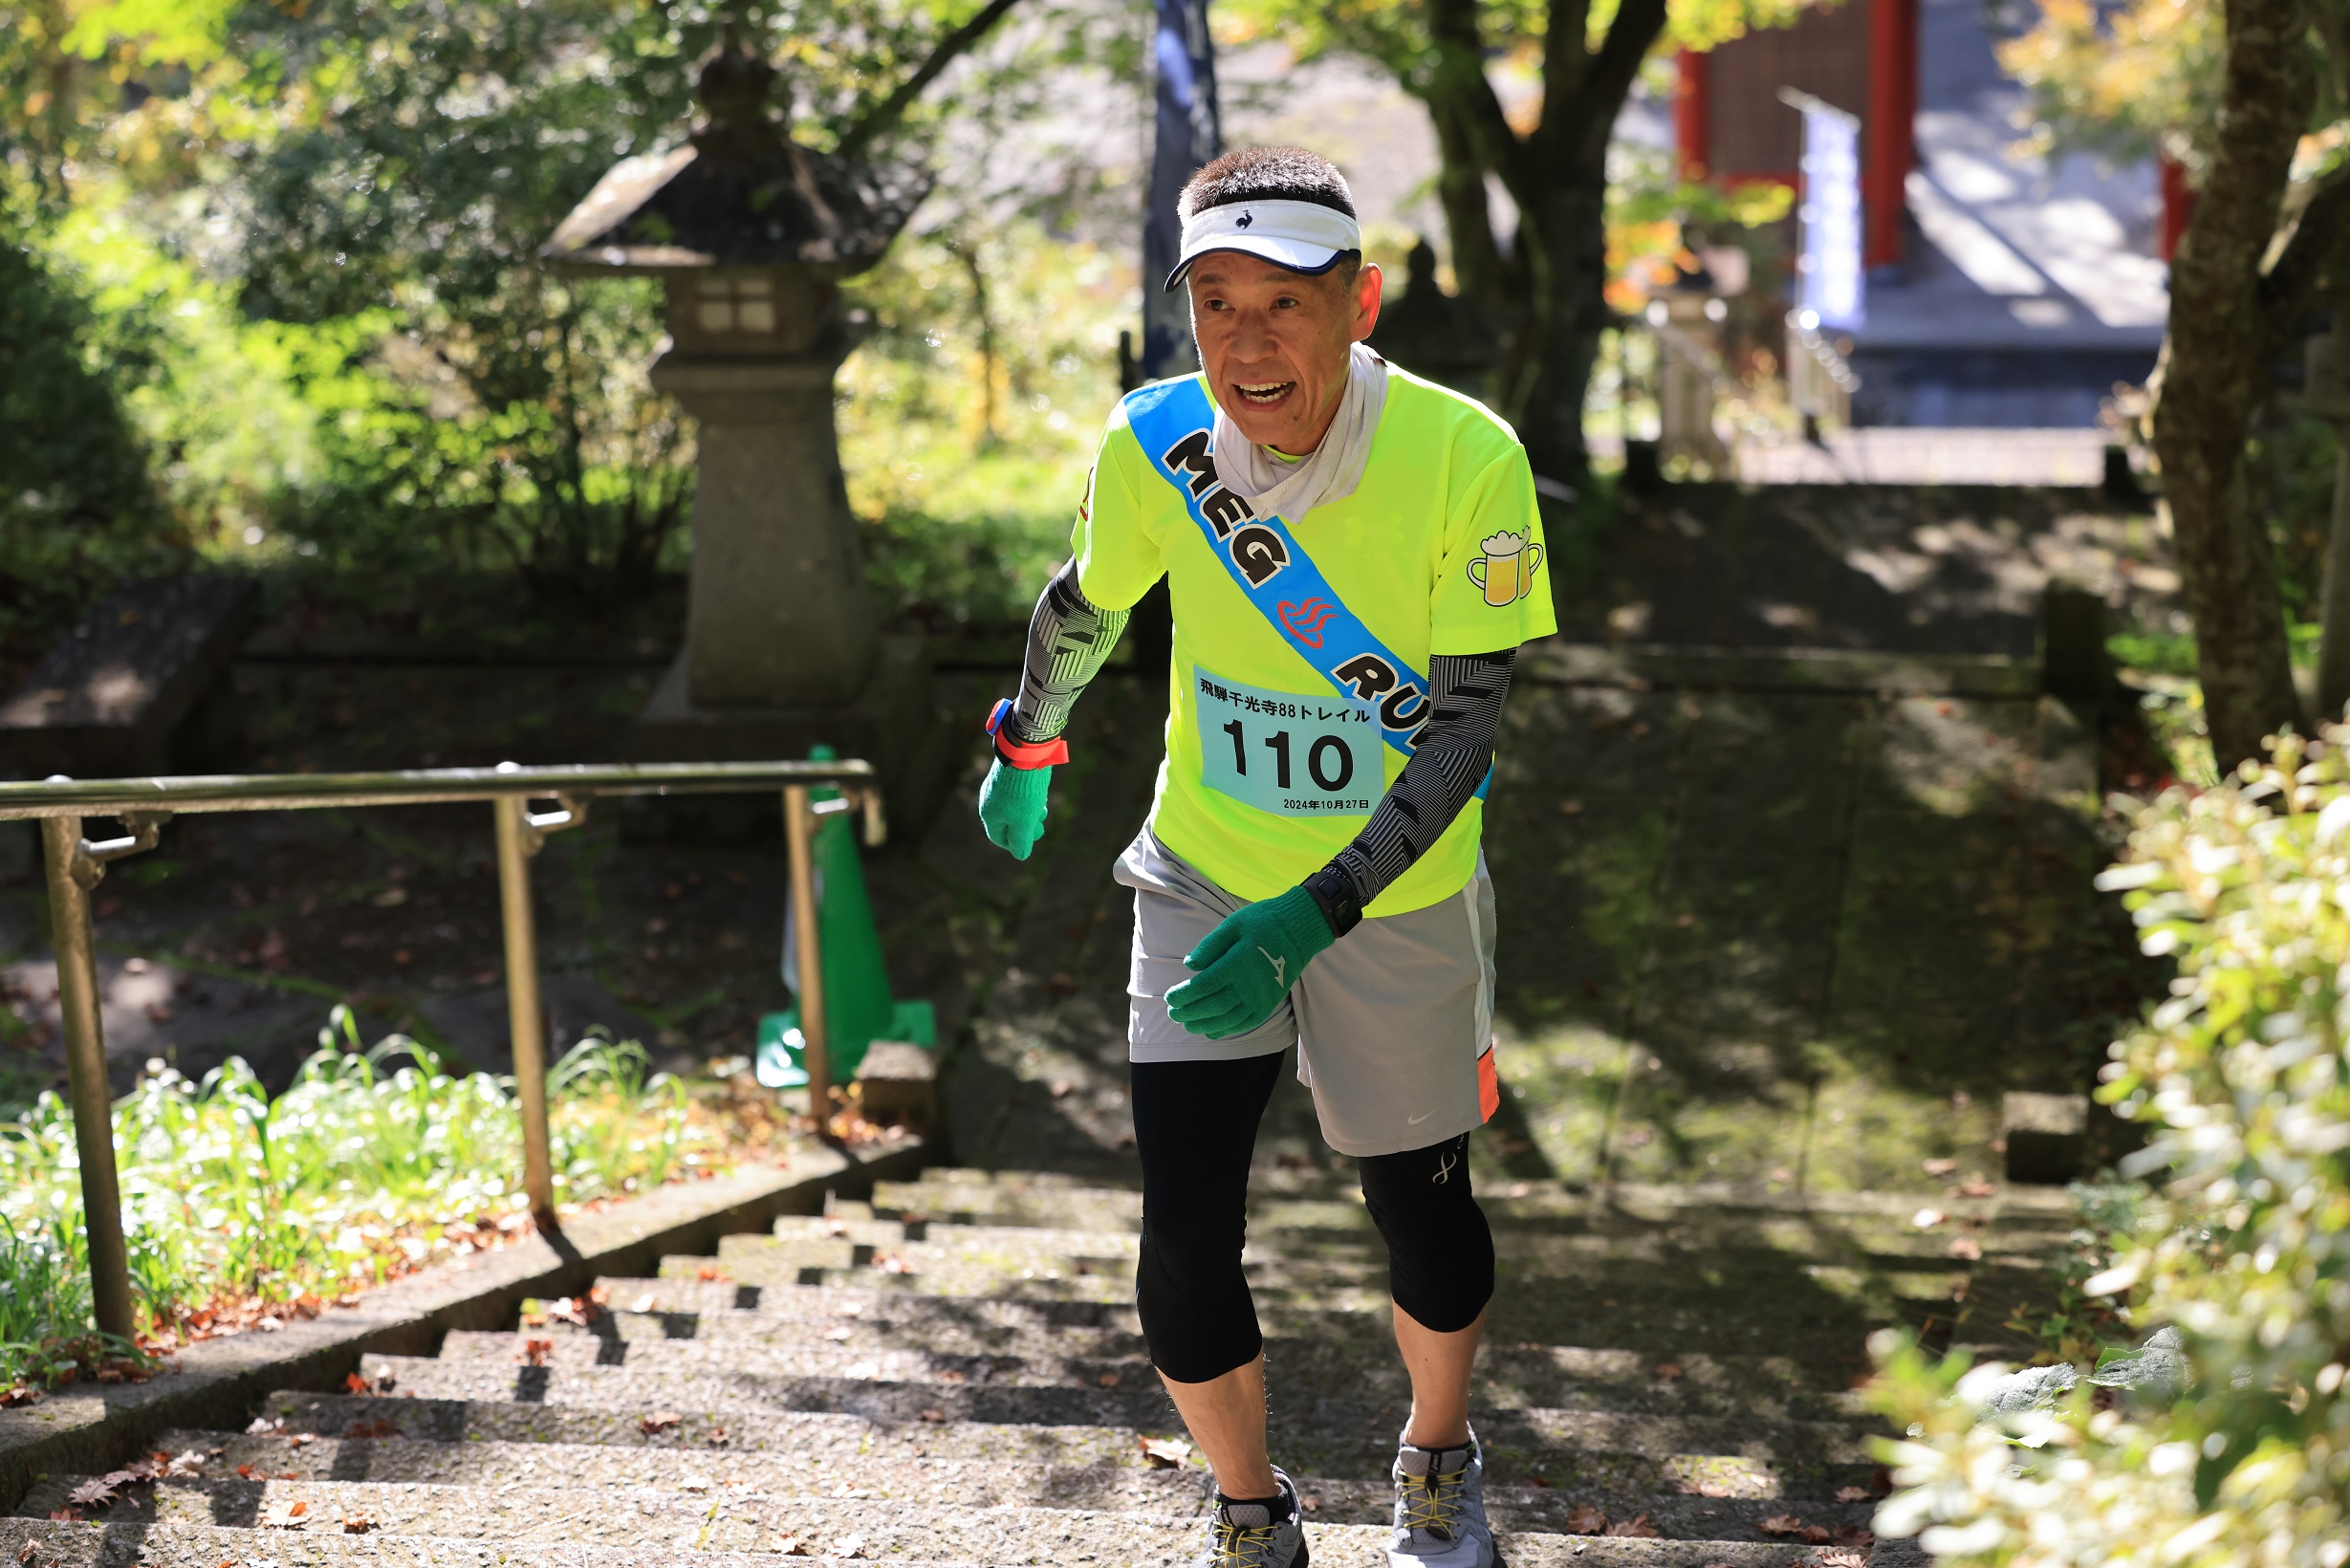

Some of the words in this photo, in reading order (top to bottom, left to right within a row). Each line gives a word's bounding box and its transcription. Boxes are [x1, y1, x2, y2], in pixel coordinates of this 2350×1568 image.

[1161, 427, 1291, 590] MEG
[1223, 718, 1354, 792] 110
[1283, 798, 1369, 810] 2024年10月27日
